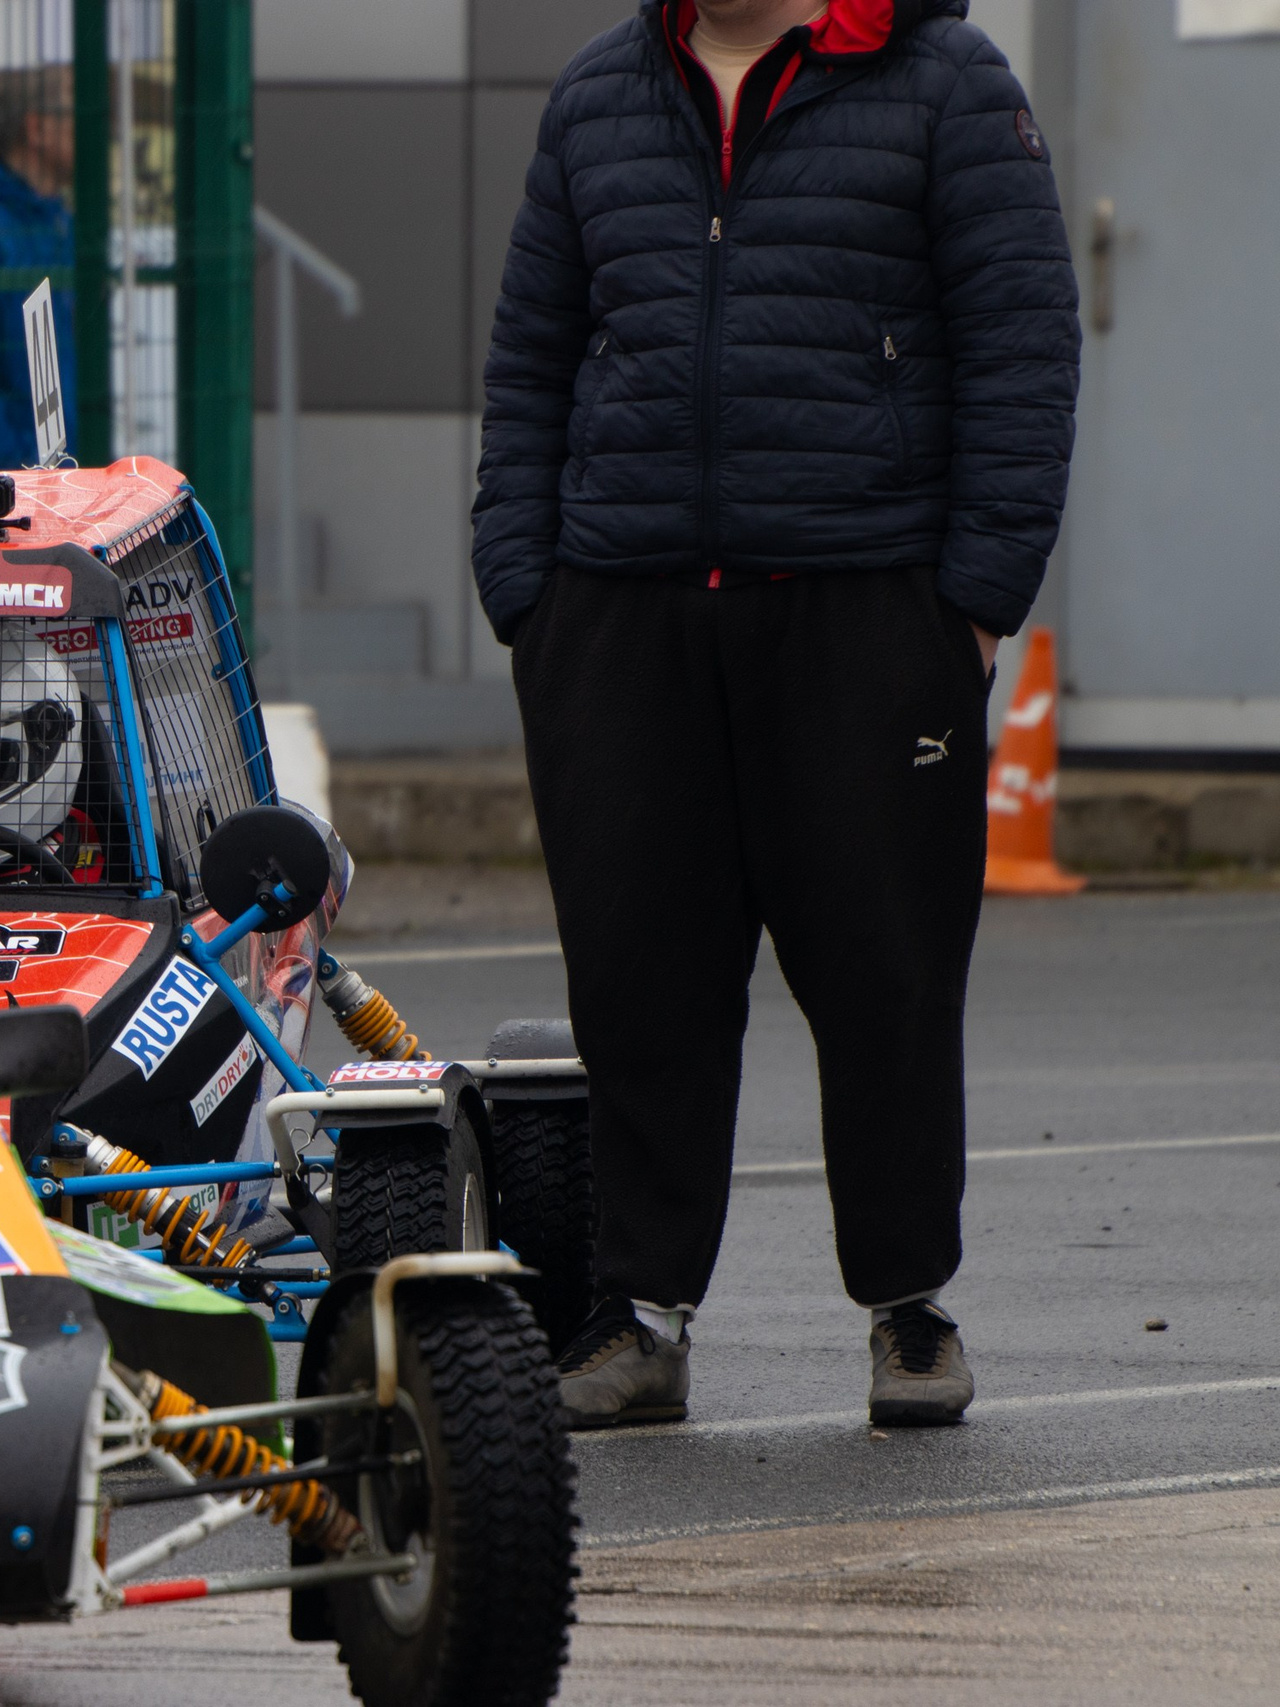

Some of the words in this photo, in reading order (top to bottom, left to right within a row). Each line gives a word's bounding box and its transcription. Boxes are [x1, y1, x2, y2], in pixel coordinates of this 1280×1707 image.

[32, 299, 61, 450] 44
[126, 577, 194, 612] ADV
[914, 751, 942, 767] PUMA
[120, 960, 216, 1075] RUSTA
[334, 1066, 439, 1082] MOLY
